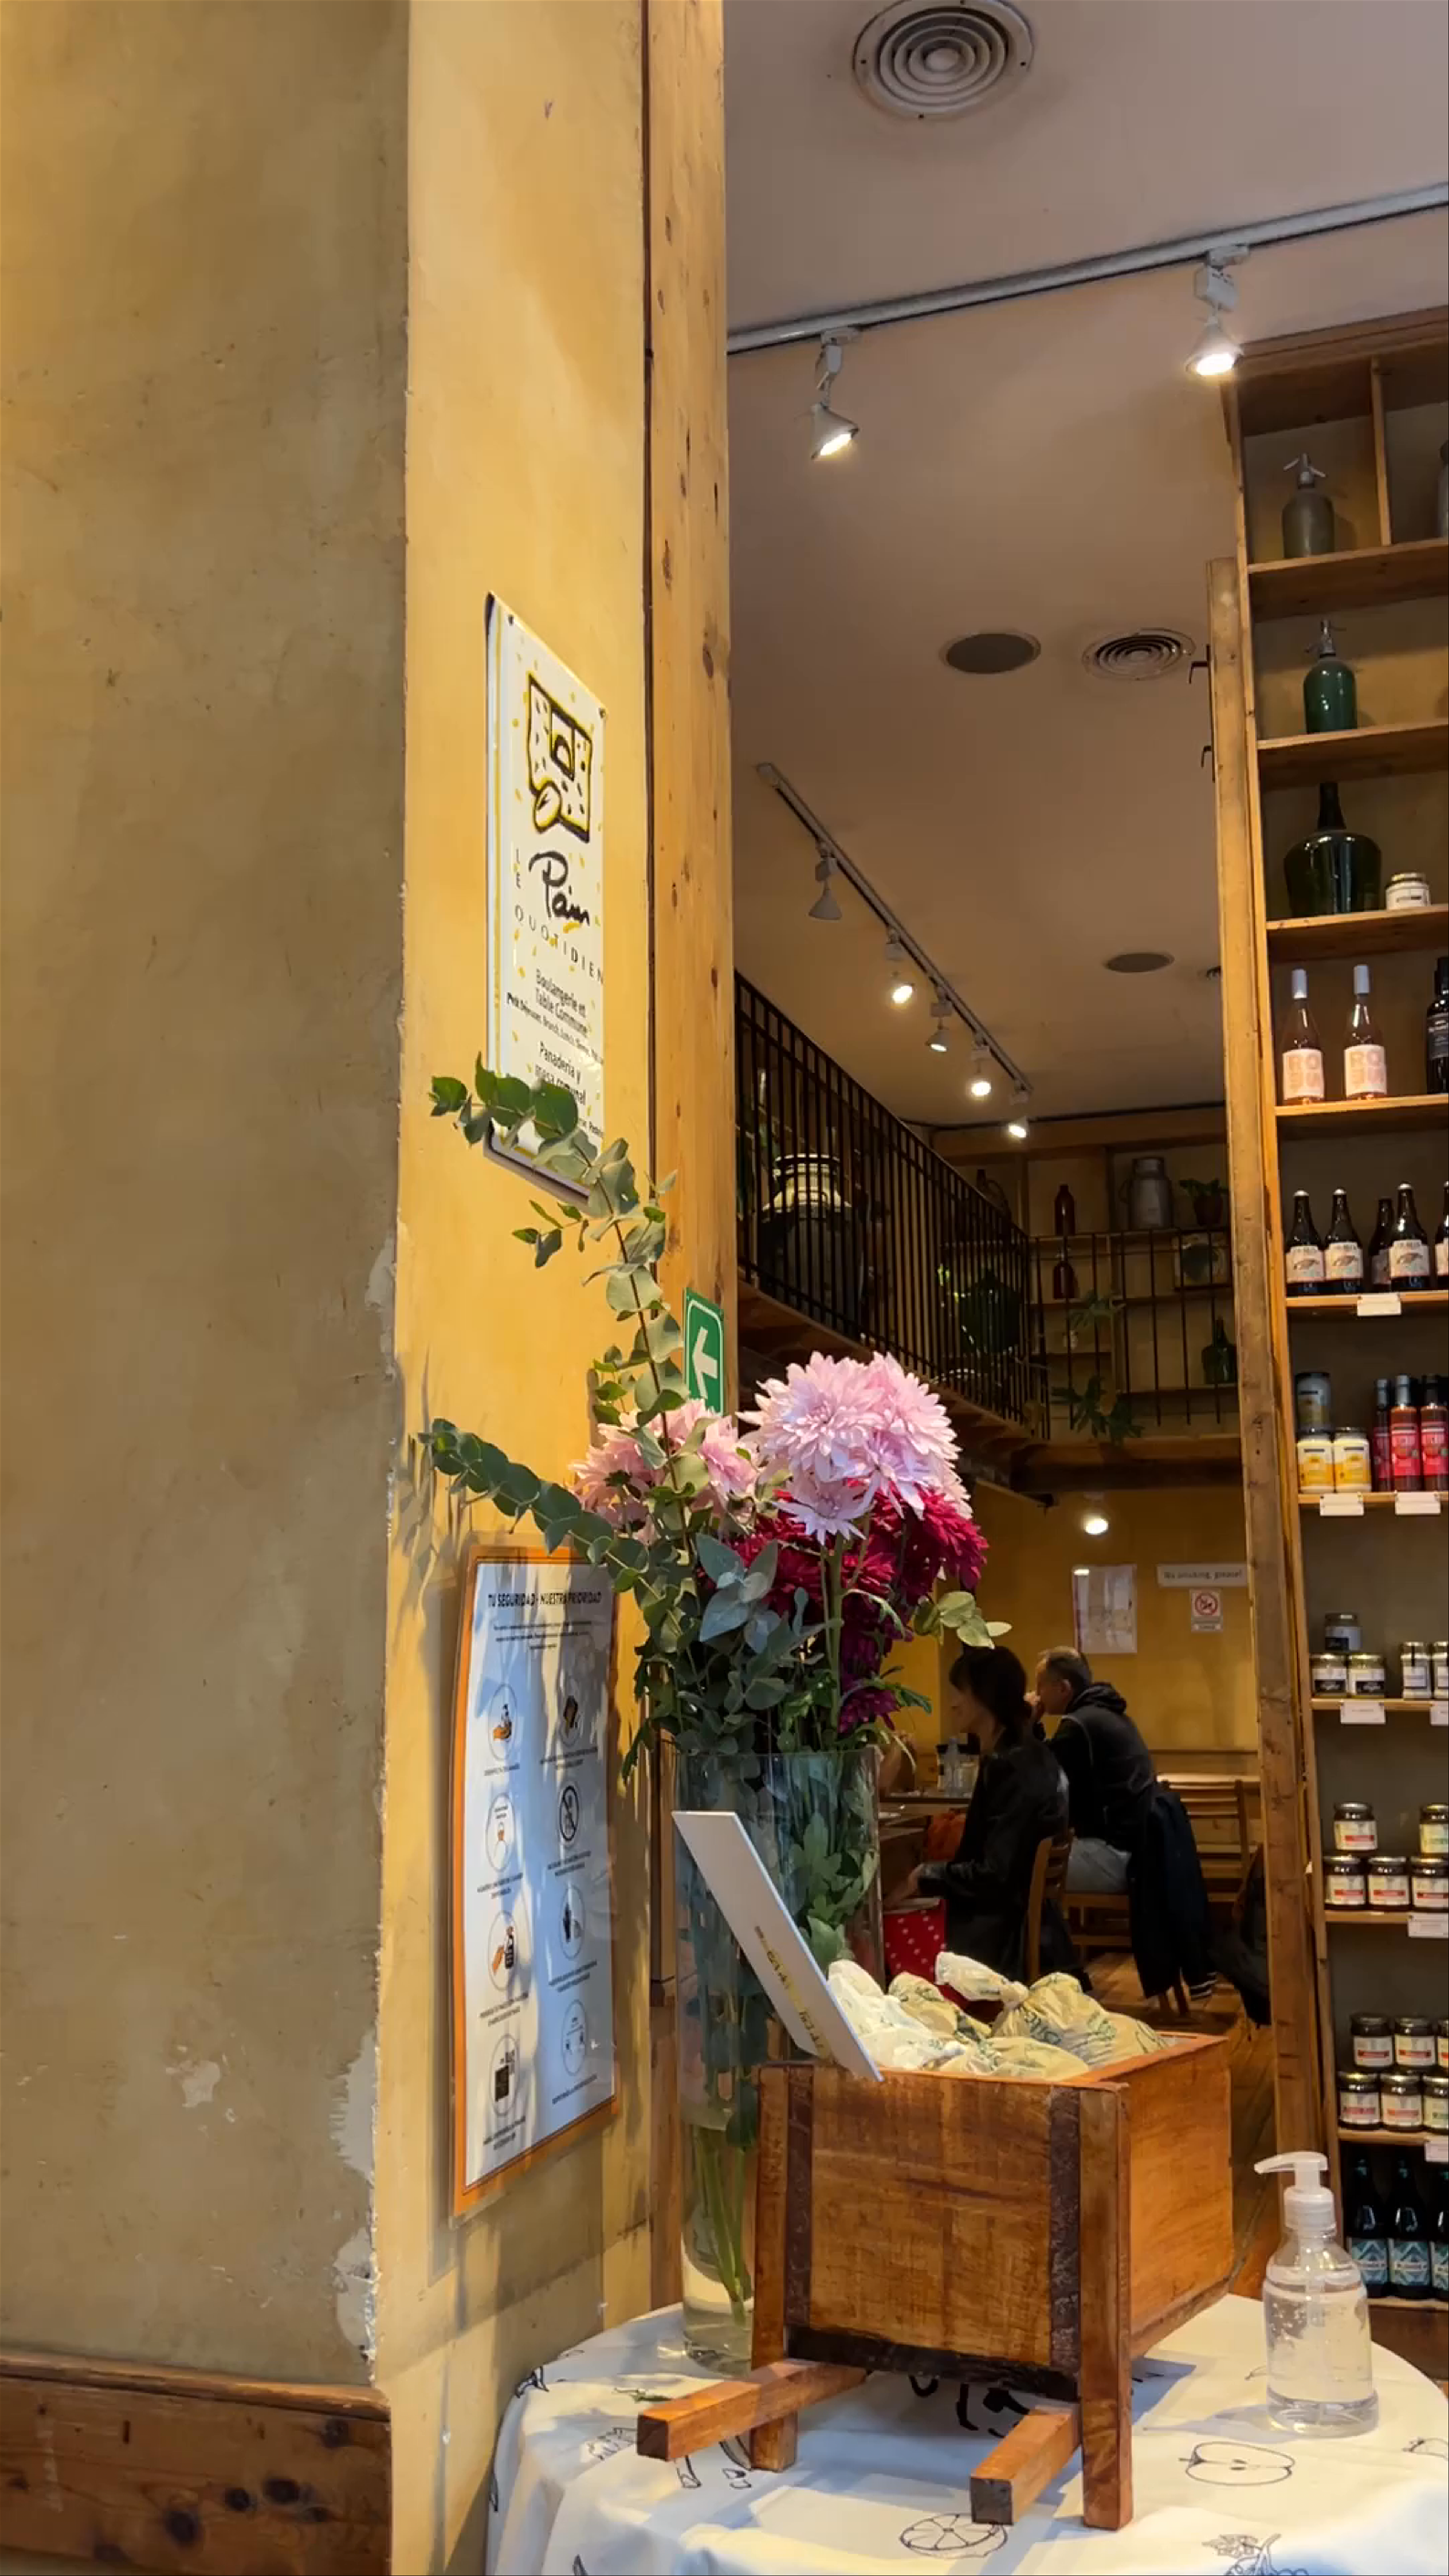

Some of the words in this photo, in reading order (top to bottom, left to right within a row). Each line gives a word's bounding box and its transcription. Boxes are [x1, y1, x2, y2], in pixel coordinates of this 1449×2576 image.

[528, 850, 590, 926] Pain
[536, 968, 577, 1013] Boulangerie
[536, 987, 554, 1014] Table
[498, 1593, 535, 1607] SEGURIDAD
